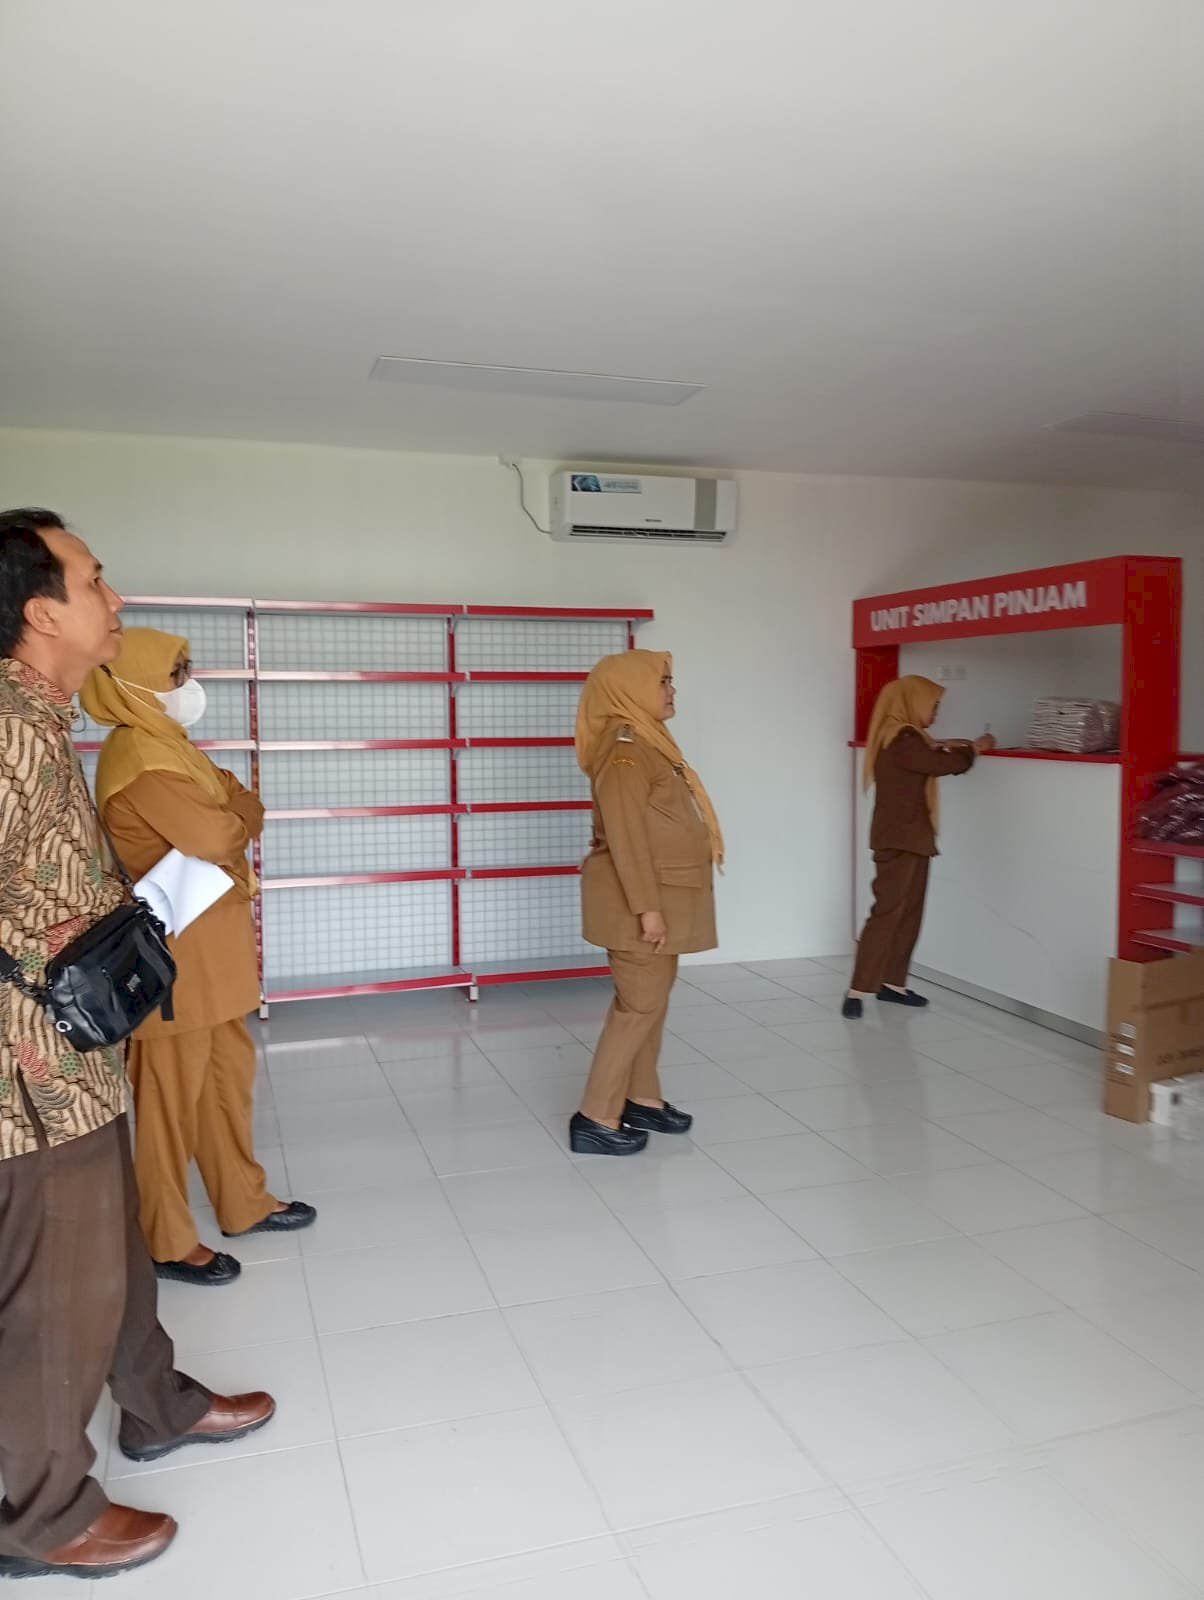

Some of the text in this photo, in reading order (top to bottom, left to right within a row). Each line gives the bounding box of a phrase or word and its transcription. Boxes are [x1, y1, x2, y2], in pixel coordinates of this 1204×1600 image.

[870, 581, 1087, 631] UNIT SIMPAN PINJAM
